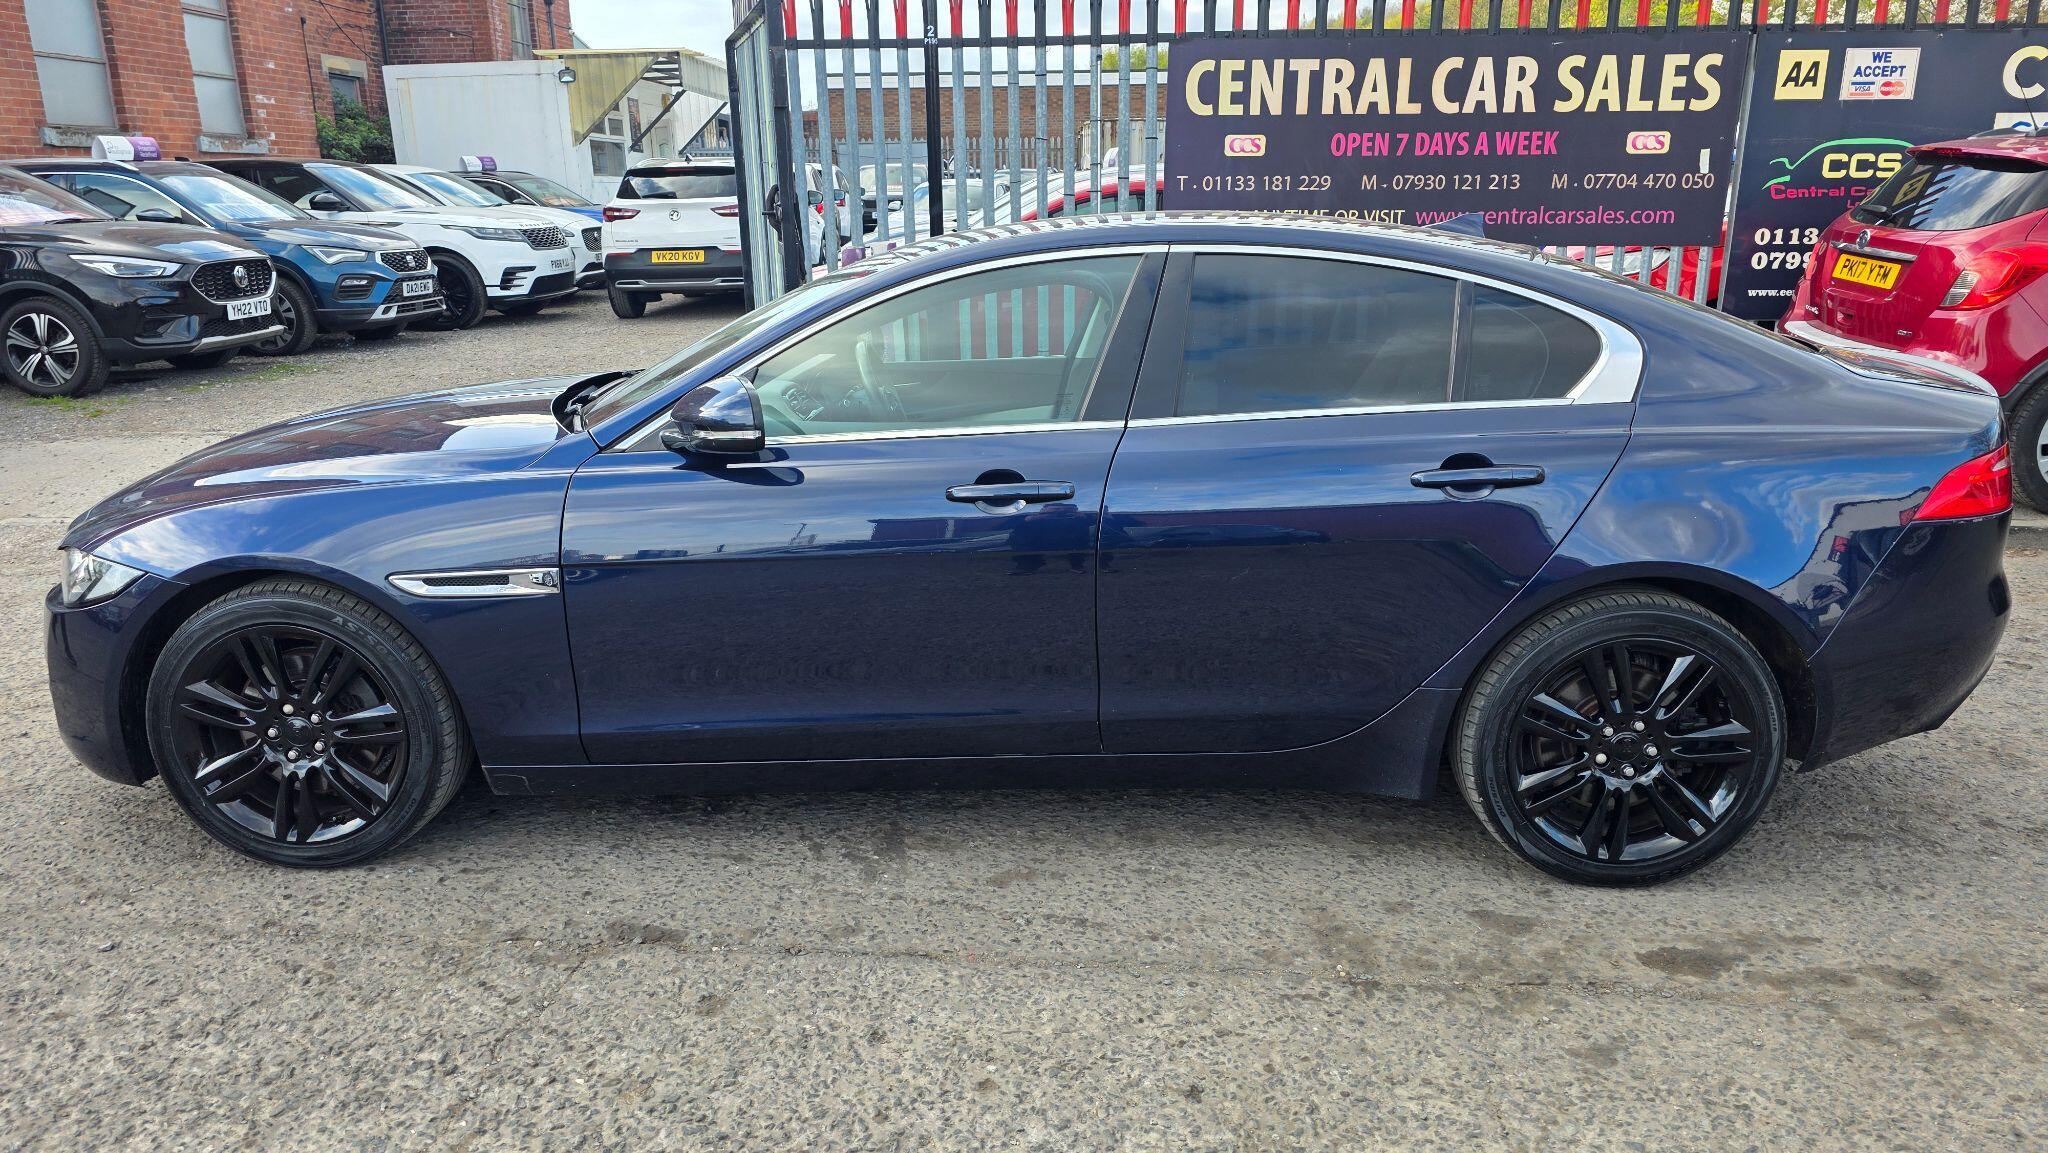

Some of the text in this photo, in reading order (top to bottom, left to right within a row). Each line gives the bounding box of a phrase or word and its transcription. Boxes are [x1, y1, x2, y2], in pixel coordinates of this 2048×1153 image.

[927, 25, 935, 37] 2
[1872, 51, 1893, 63] WE
[1781, 60, 1820, 88] AA
[1853, 65, 1906, 78] ACCEPT
[2002, 45, 2048, 99] C
[1185, 53, 1724, 116] CENTRAL CAR SALES
[1228, 137, 1262, 154] CCS
[1330, 131, 1559, 157] OPEN 7 DAYS A WEEK
[1631, 134, 1666, 151] CCS
[1821, 152, 1903, 179] CCS
[1202, 175, 1255, 191] 01133
[1263, 175, 1291, 191] 181
[1299, 174, 1332, 191] 229
[1392, 174, 1446, 190] 07930
[1453, 174, 1481, 190] 121
[1488, 174, 1521, 190] 213
[1583, 173, 1638, 189] 07704
[1643, 173, 1676, 189] 470
[1681, 173, 1715, 189] 050
[1770, 184, 1845, 200] Central
[1363, 209, 1406, 225] VISIT
[1415, 206, 1675, 224] wwentralcarsales.com
[1754, 227, 1819, 246] 0113
[655, 252, 701, 261] VK20 KGV
[1840, 258, 1893, 284] PK17 YTM
[231, 300, 268, 317] YH22 VTO
